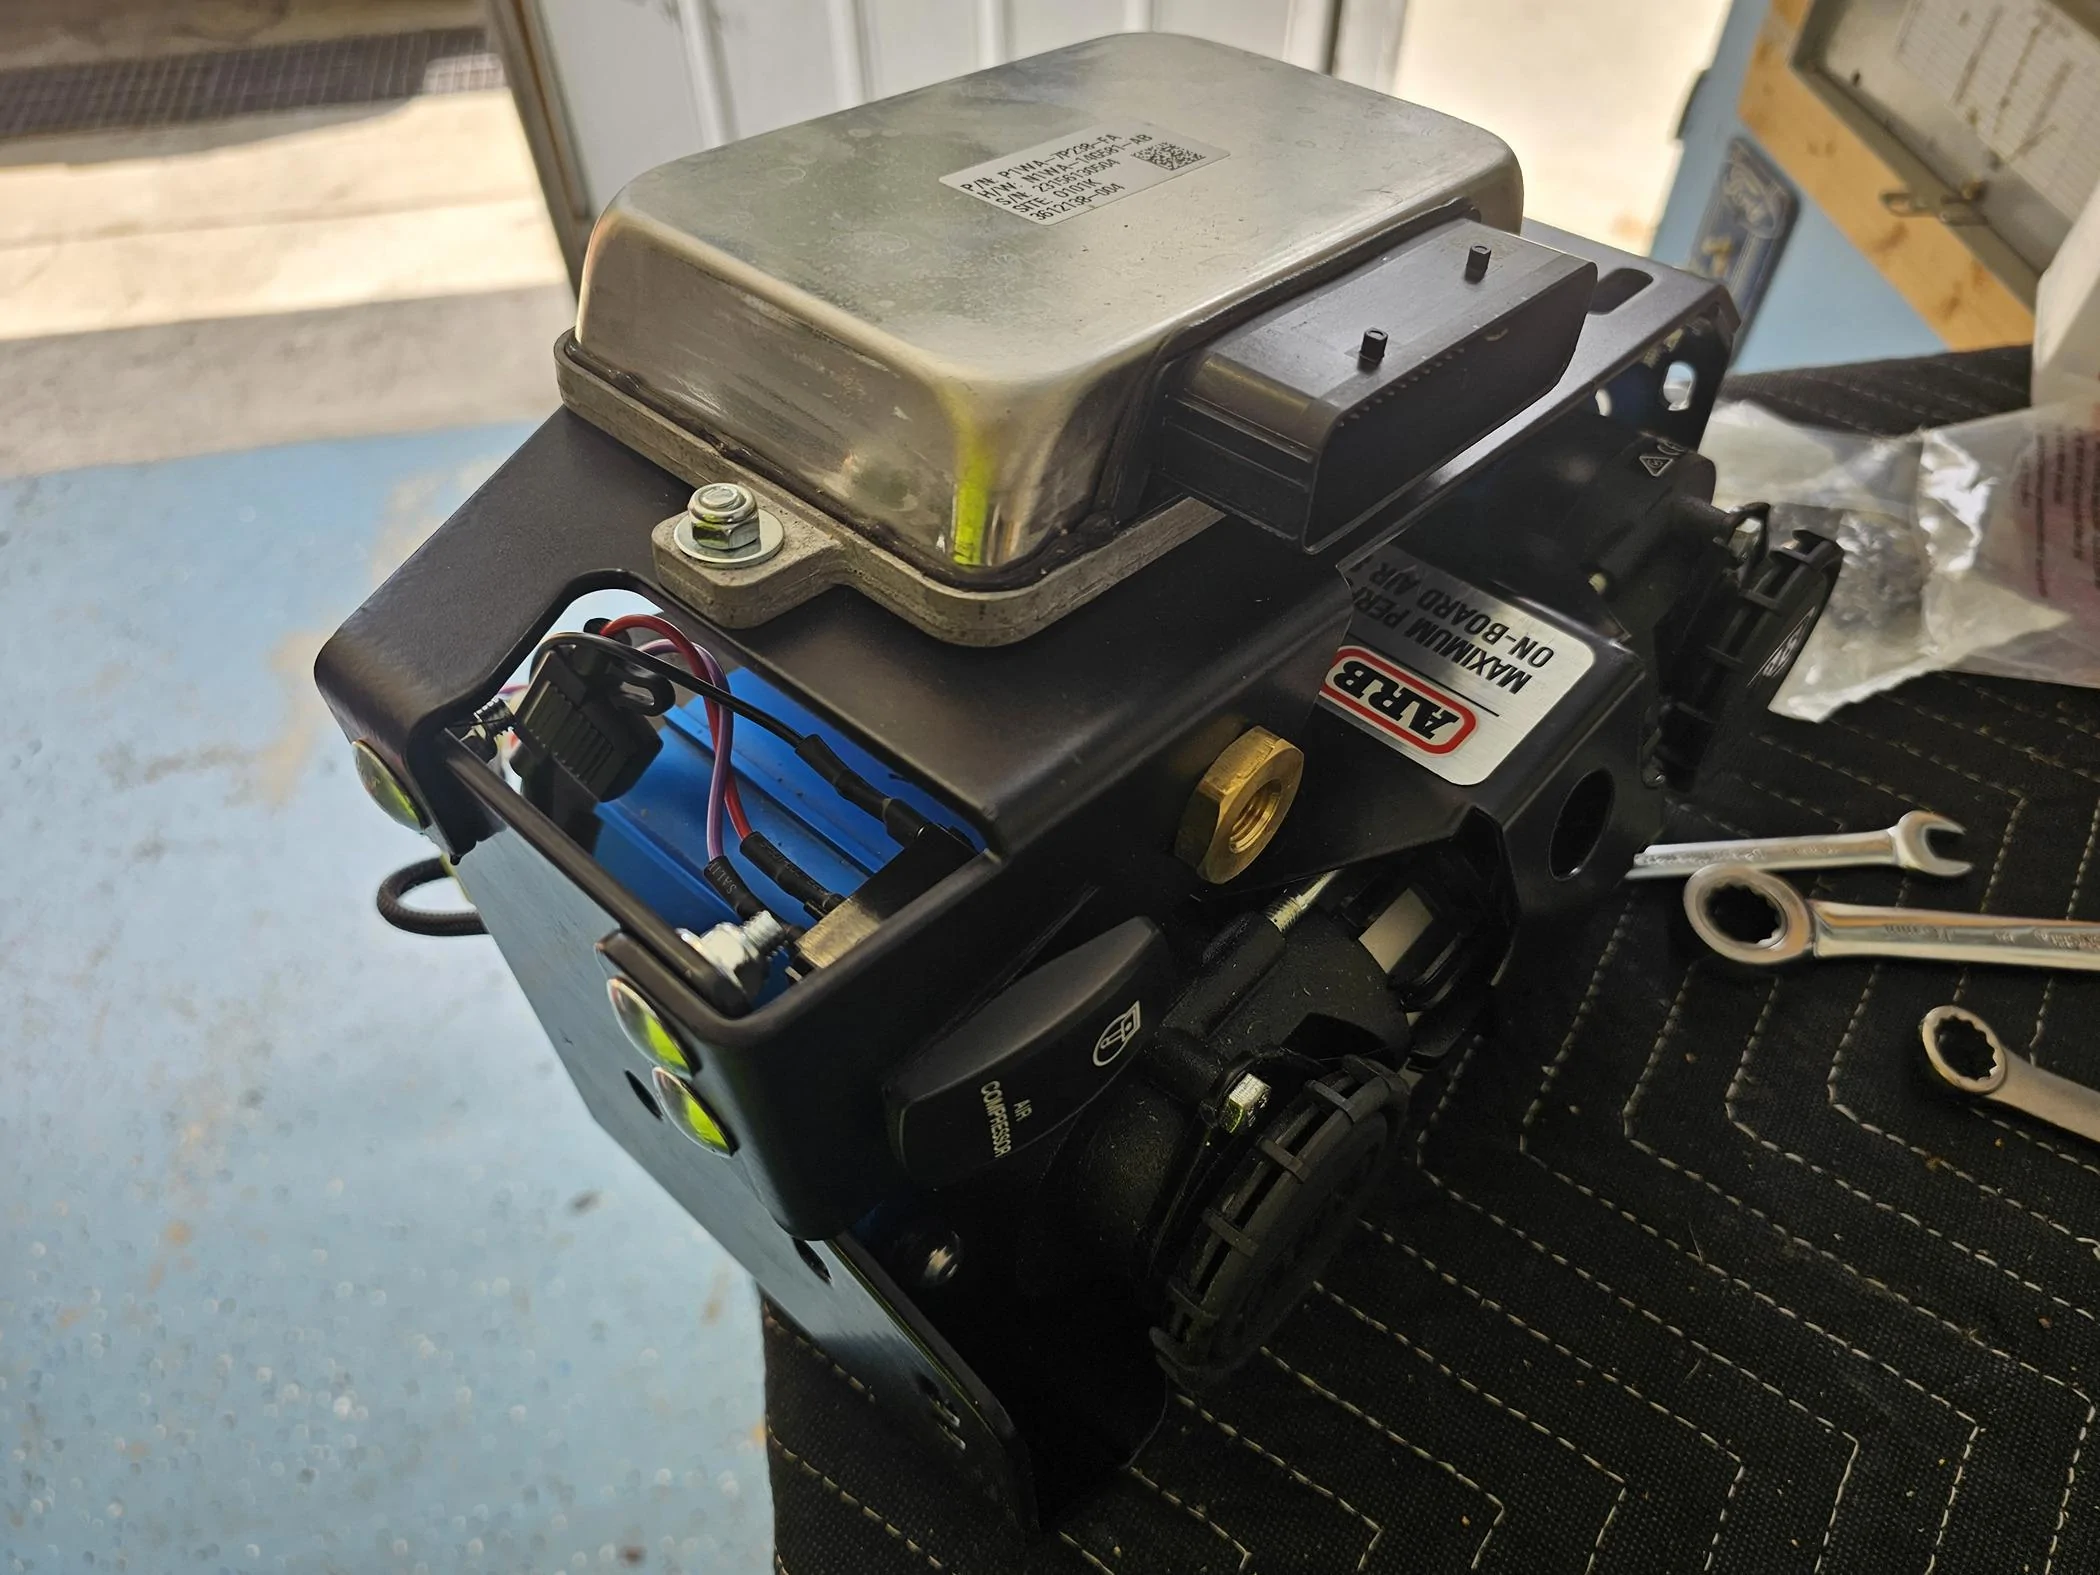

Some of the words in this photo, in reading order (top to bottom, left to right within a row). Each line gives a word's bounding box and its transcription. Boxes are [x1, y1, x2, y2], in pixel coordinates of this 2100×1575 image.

[1012, 197, 1053, 212] SITE:
[1029, 183, 1125, 220] 3612138-004
[1369, 561, 1424, 597] AIR
[1406, 618, 1532, 694] MAXIMUM
[1416, 588, 1554, 668] ON-BOARD
[1333, 660, 1460, 740] ARB
[981, 1080, 1012, 1158] COMPRESSOR
[1014, 1098, 1032, 1121] AIR
